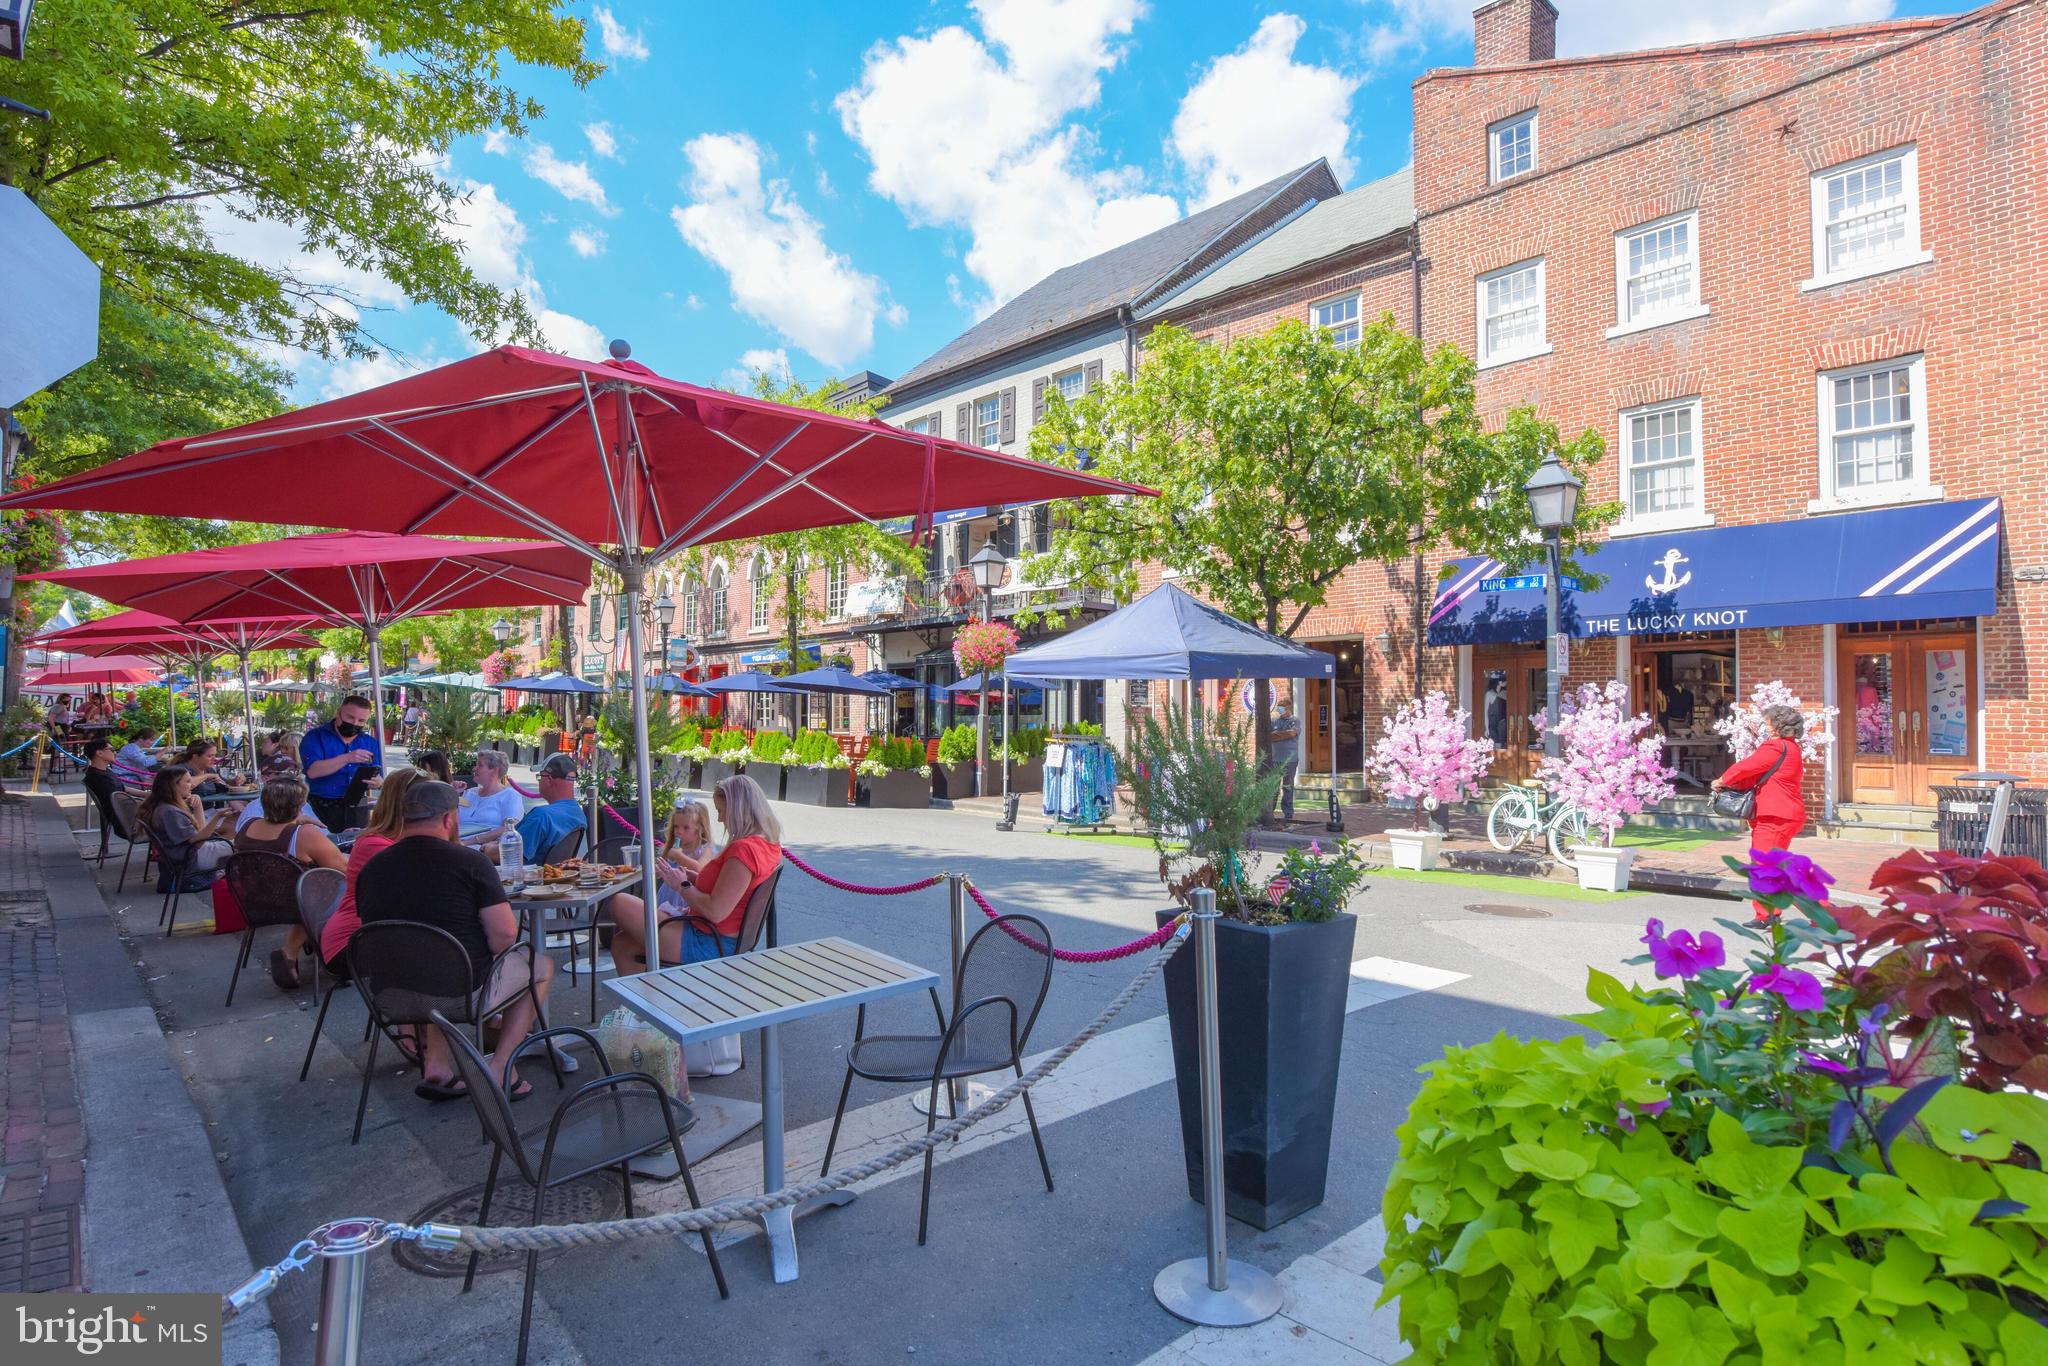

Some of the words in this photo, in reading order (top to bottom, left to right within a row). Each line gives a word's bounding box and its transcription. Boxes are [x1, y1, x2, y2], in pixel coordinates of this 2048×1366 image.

[1482, 579, 1506, 591] KING
[1586, 618, 1620, 633] THE
[1627, 614, 1686, 631] LUCKY
[1693, 609, 1748, 626] KNOT
